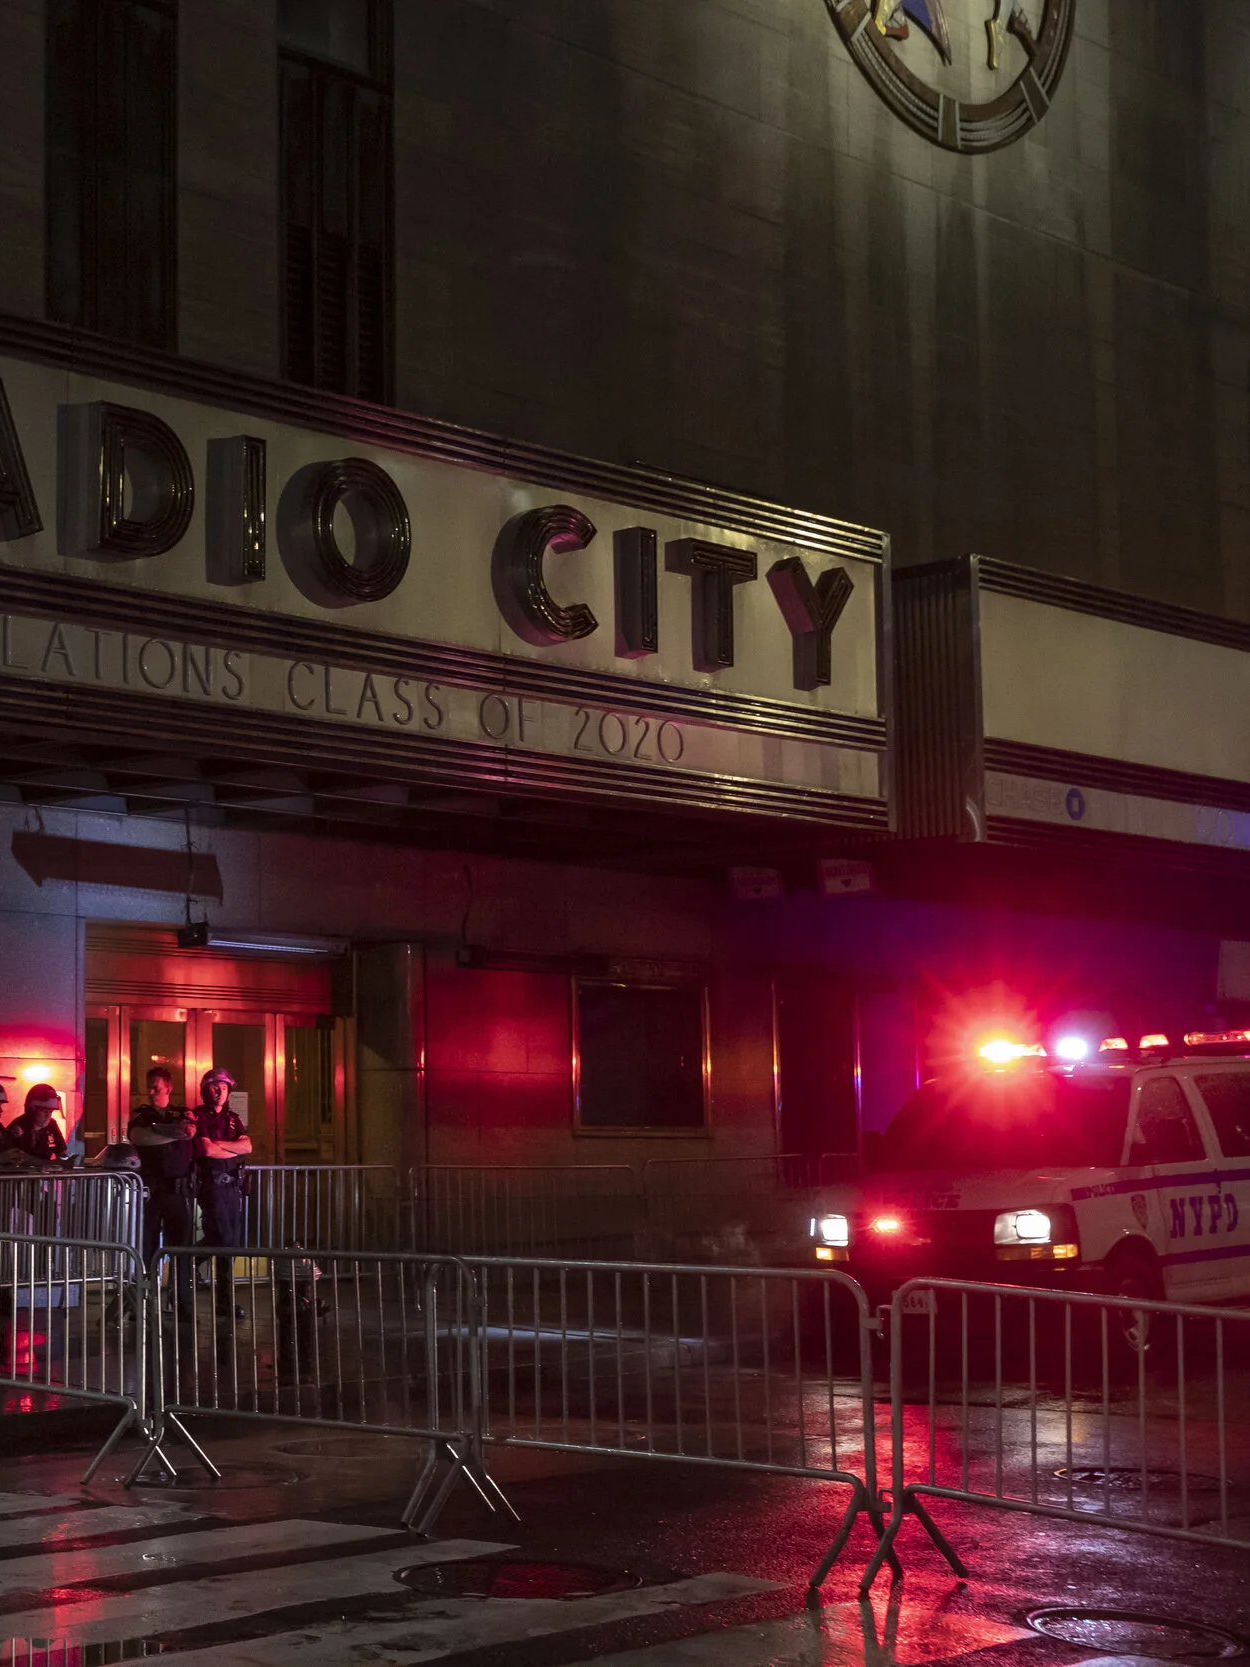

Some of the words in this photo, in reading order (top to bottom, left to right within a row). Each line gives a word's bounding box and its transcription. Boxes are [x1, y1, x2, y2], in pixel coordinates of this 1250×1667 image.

[492, 503, 855, 692] CITY
[287, 660, 445, 731] CLASS
[479, 692, 538, 746] OF
[573, 707, 686, 764] 2020
[1170, 1193, 1238, 1239] NYPD
